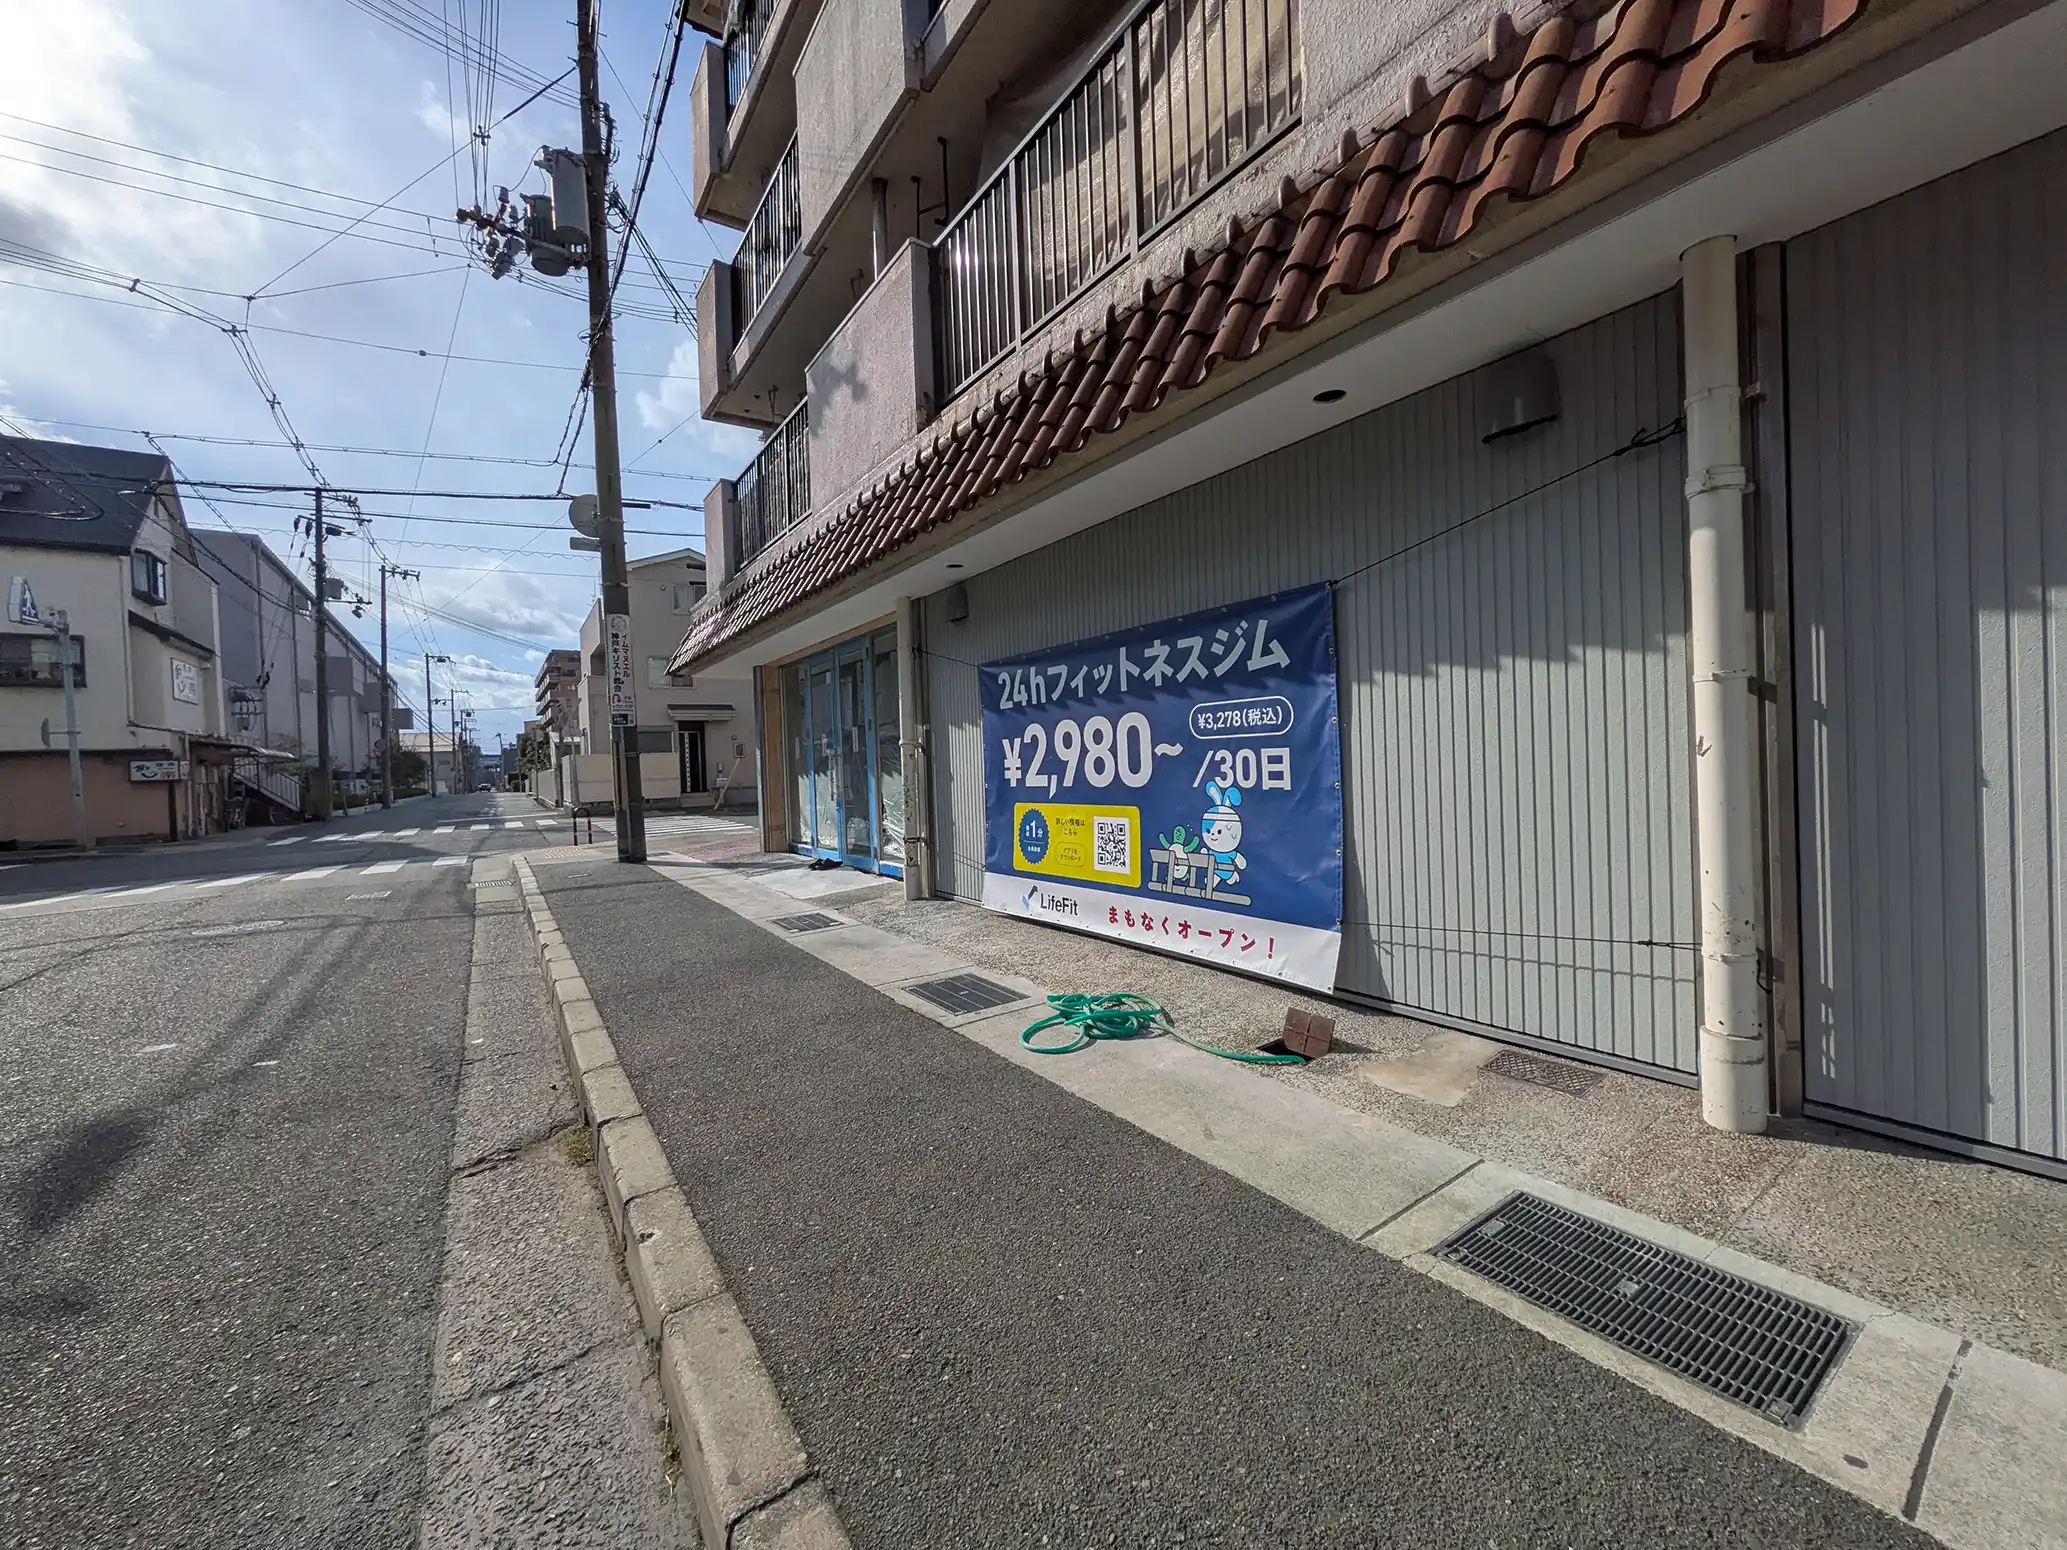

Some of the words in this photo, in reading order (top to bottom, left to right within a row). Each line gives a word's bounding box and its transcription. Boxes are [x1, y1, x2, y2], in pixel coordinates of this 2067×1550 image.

[998, 619, 1291, 710] 24hフィットネスジム
[1197, 705, 1284, 730] ¥3,278(税込)
[1193, 747, 1292, 791] /30日
[1063, 827, 1078, 837] こちら
[1039, 888, 1079, 917] LifeFit
[1107, 905, 1276, 960] まもなくオープン!
